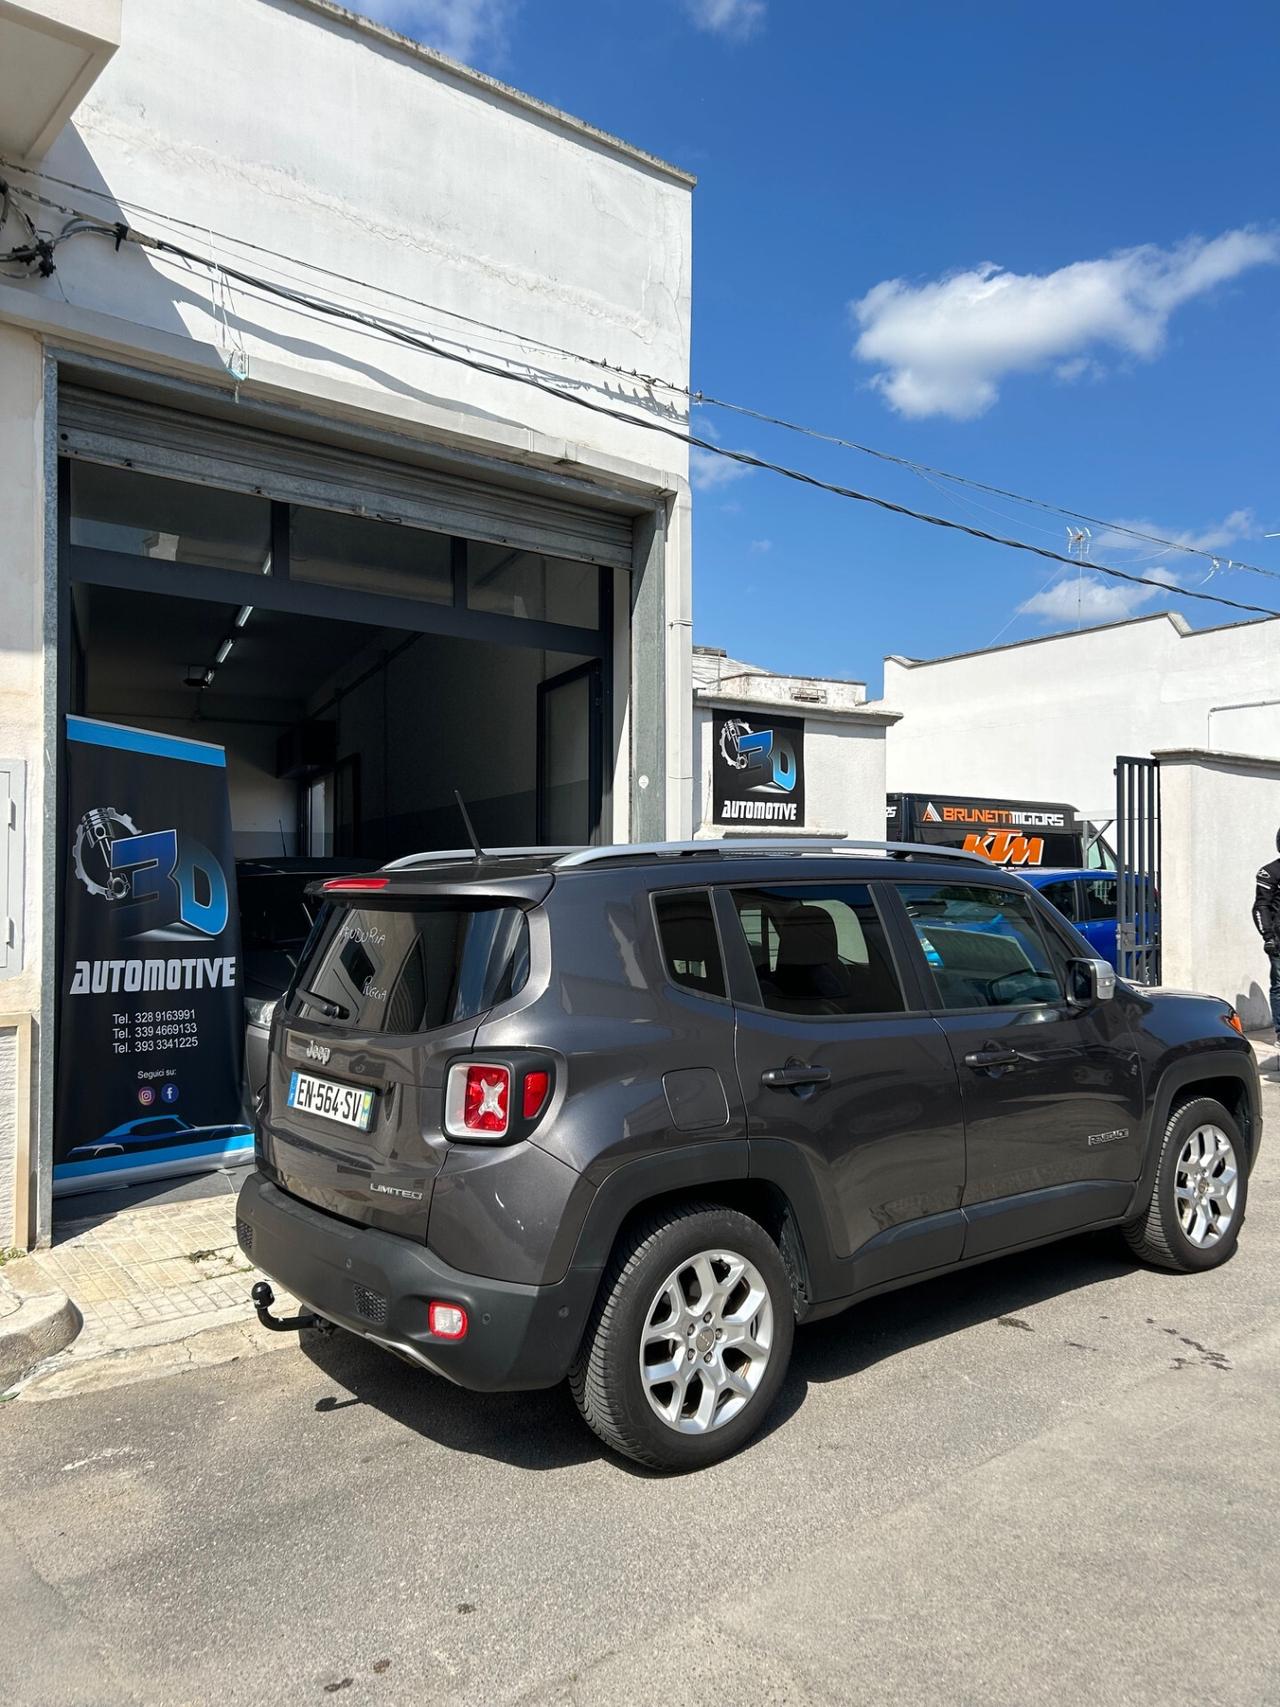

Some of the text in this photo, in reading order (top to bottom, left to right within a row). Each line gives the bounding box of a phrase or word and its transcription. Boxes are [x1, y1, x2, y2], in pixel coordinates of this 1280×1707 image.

[737, 729, 797, 791] 3D
[721, 800, 797, 821] AUTOMOTIVE
[961, 828, 1045, 865] KTM
[111, 828, 229, 935] 3D
[69, 956, 236, 995] AUTOMOTIVE
[112, 1009, 195, 1025] Tel. 328 9163991
[112, 1022, 198, 1039] Tel. 339 4669133
[112, 1036, 199, 1054] Tel. 393 3341225
[306, 1039, 331, 1064] Jeep
[137, 1068, 177, 1080] Seguici su:
[370, 1183, 423, 1200] LIMITED
